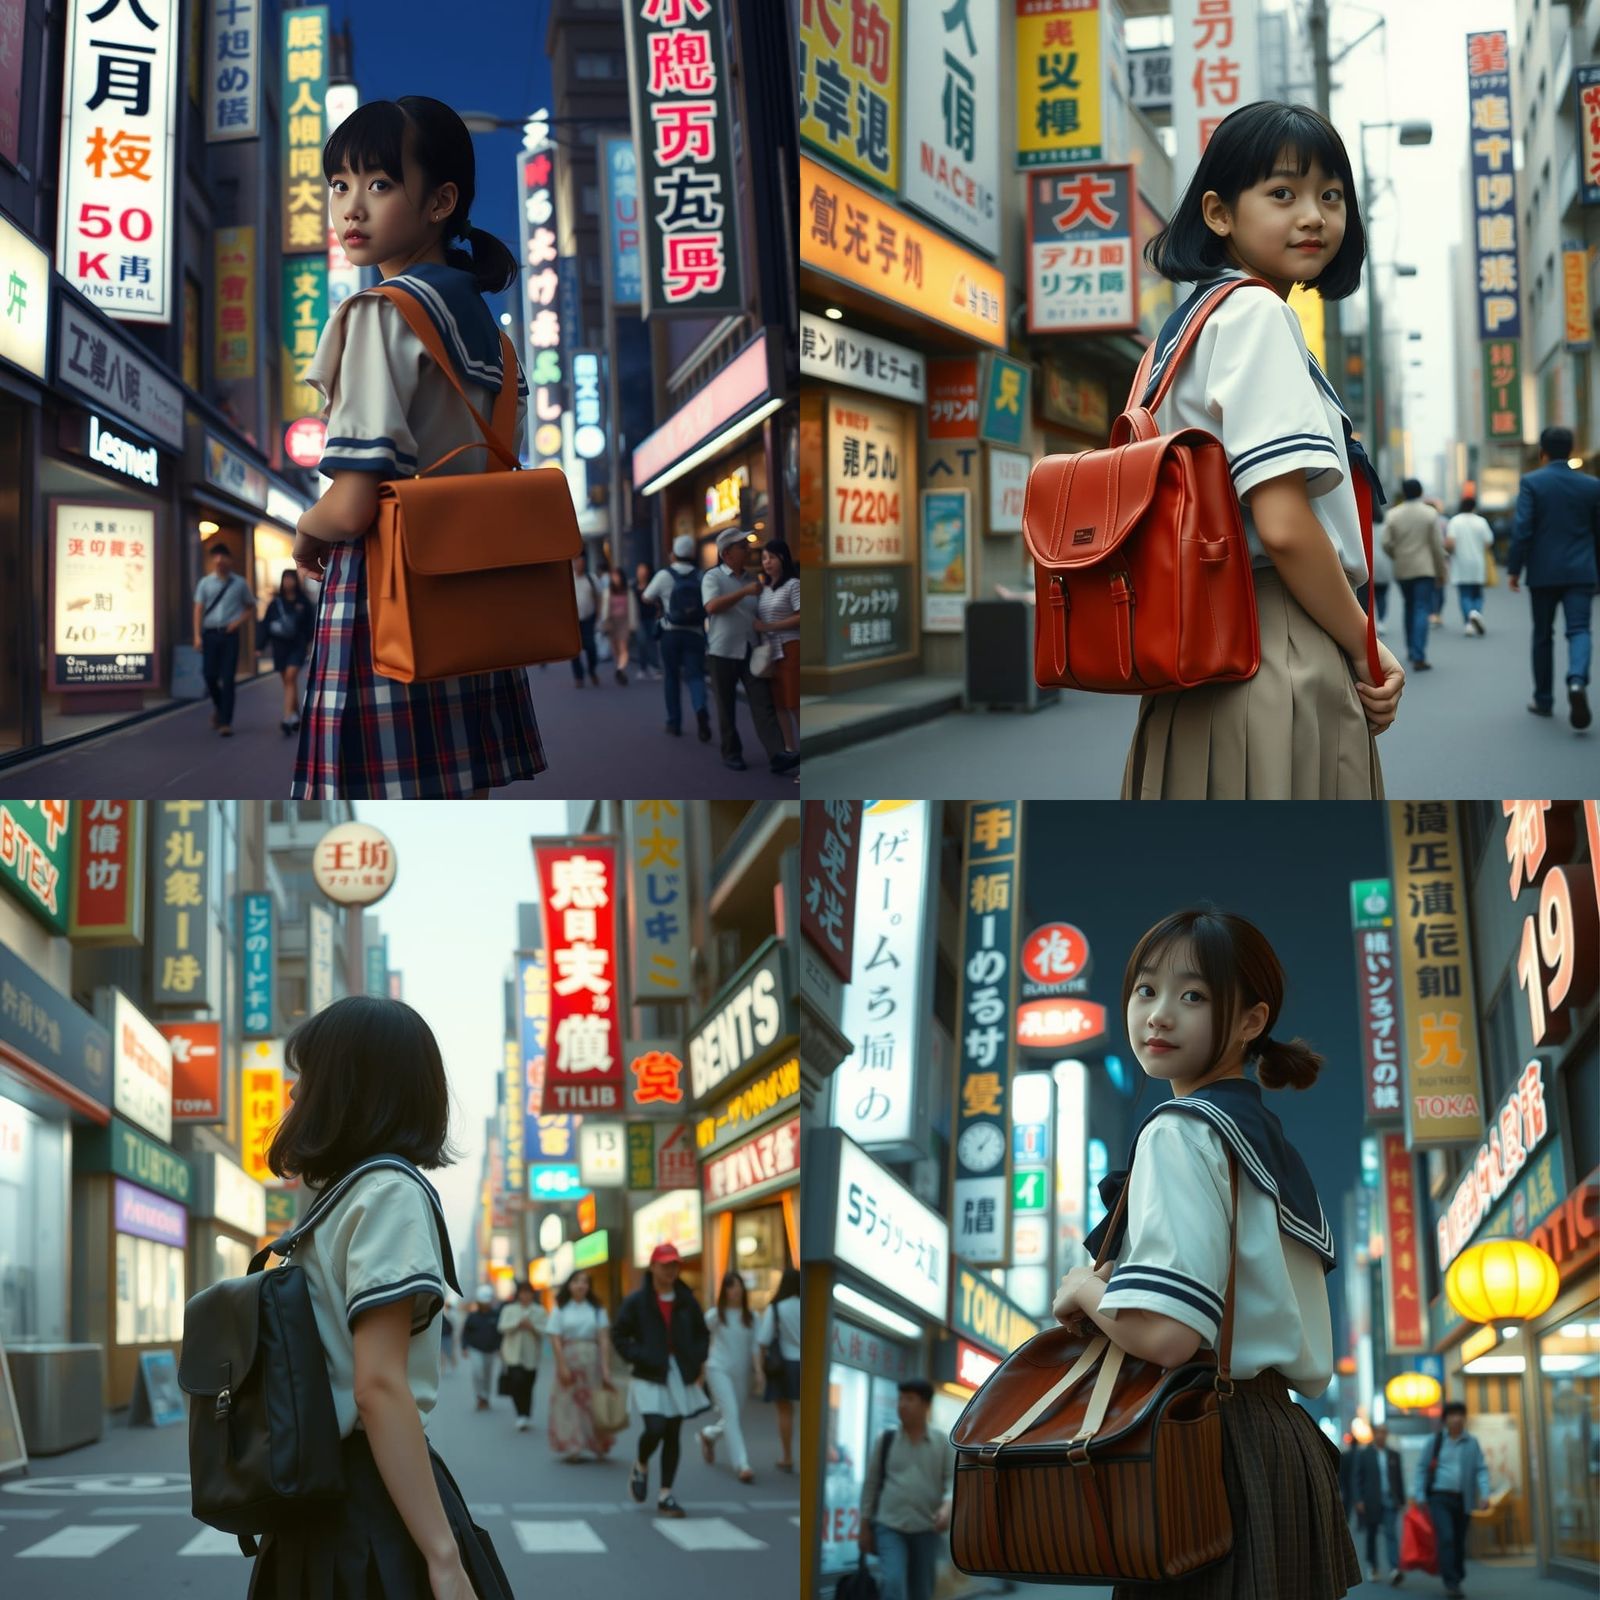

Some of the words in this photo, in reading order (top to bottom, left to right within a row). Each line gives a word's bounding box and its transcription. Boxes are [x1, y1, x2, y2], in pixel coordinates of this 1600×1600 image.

[78, 203, 153, 242] 50
[1052, 174, 1120, 234] 大
[78, 251, 110, 281] K
[836, 487, 900, 525] 72204
[1517, 866, 1575, 1048] 19
[689, 968, 780, 1100] BENTS
[1413, 1095, 1480, 1121] TOKA
